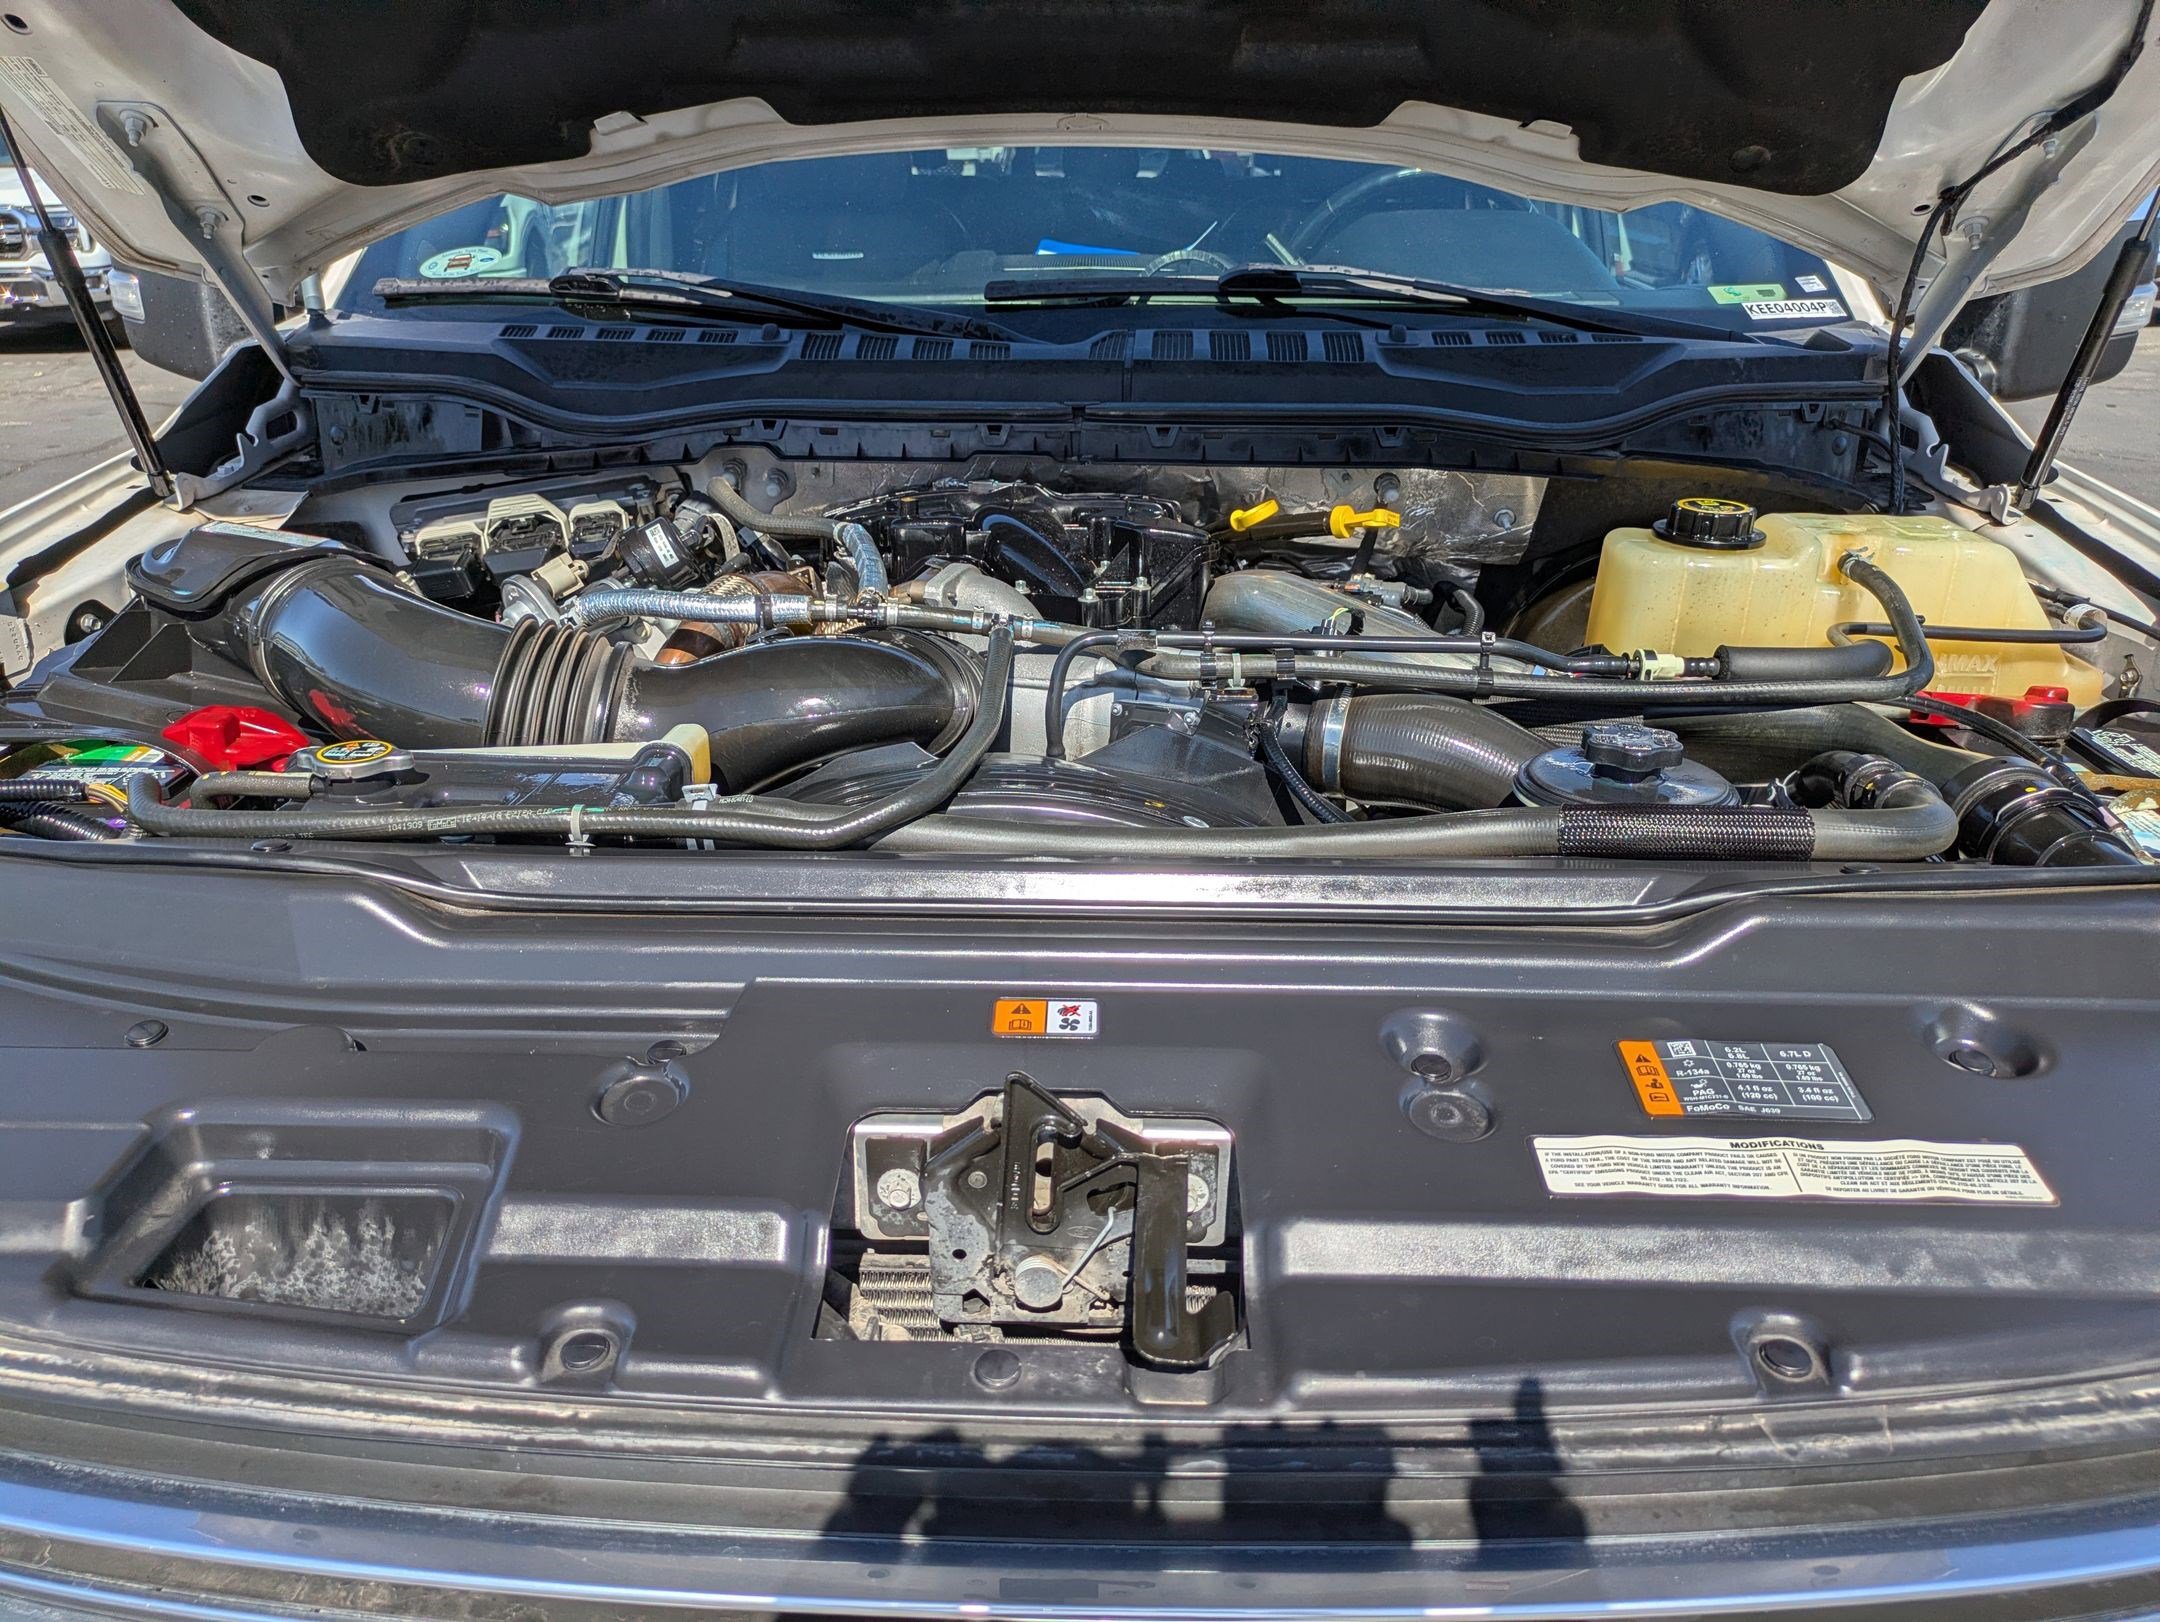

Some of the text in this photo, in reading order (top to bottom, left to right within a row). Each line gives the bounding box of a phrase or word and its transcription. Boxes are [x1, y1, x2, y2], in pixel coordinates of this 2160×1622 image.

[1745, 302, 1826, 314] KEE04004P
[1676, 1068, 1710, 1077] R-134a
[1692, 1088, 1715, 1096] PAG
[1686, 1103, 1730, 1112] FoMoCo
[1730, 1140, 1824, 1150] MODIFICATIONS
